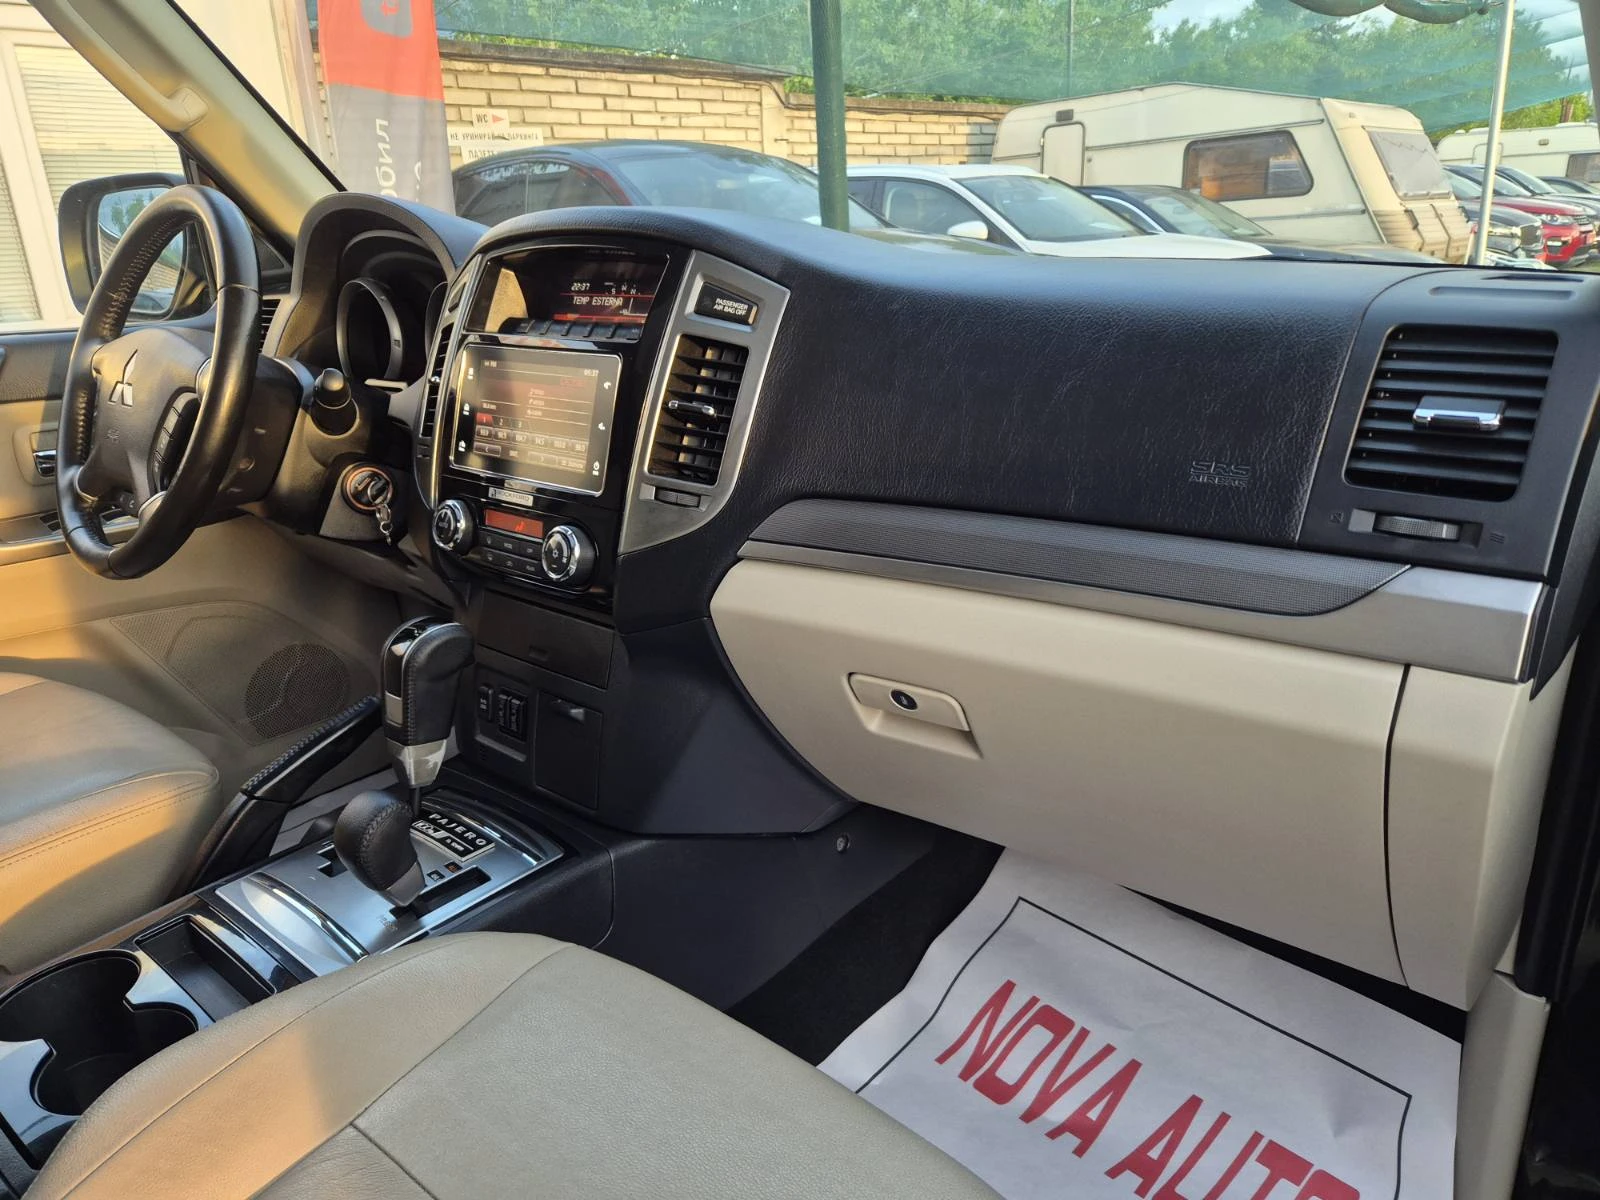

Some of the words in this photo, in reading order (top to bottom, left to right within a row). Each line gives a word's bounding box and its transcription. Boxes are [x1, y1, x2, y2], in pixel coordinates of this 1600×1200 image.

[476, 113, 488, 124] WC
[450, 133, 459, 141] НЕ
[573, 296, 590, 305] TEMP
[592, 297, 623, 306] ESTERNA
[715, 298, 749, 310] PASSENGER
[723, 306, 735, 314] BAG
[1190, 460, 1252, 478] SRS
[428, 813, 487, 846] PAJERO
[934, 979, 1143, 1159] NOVA
